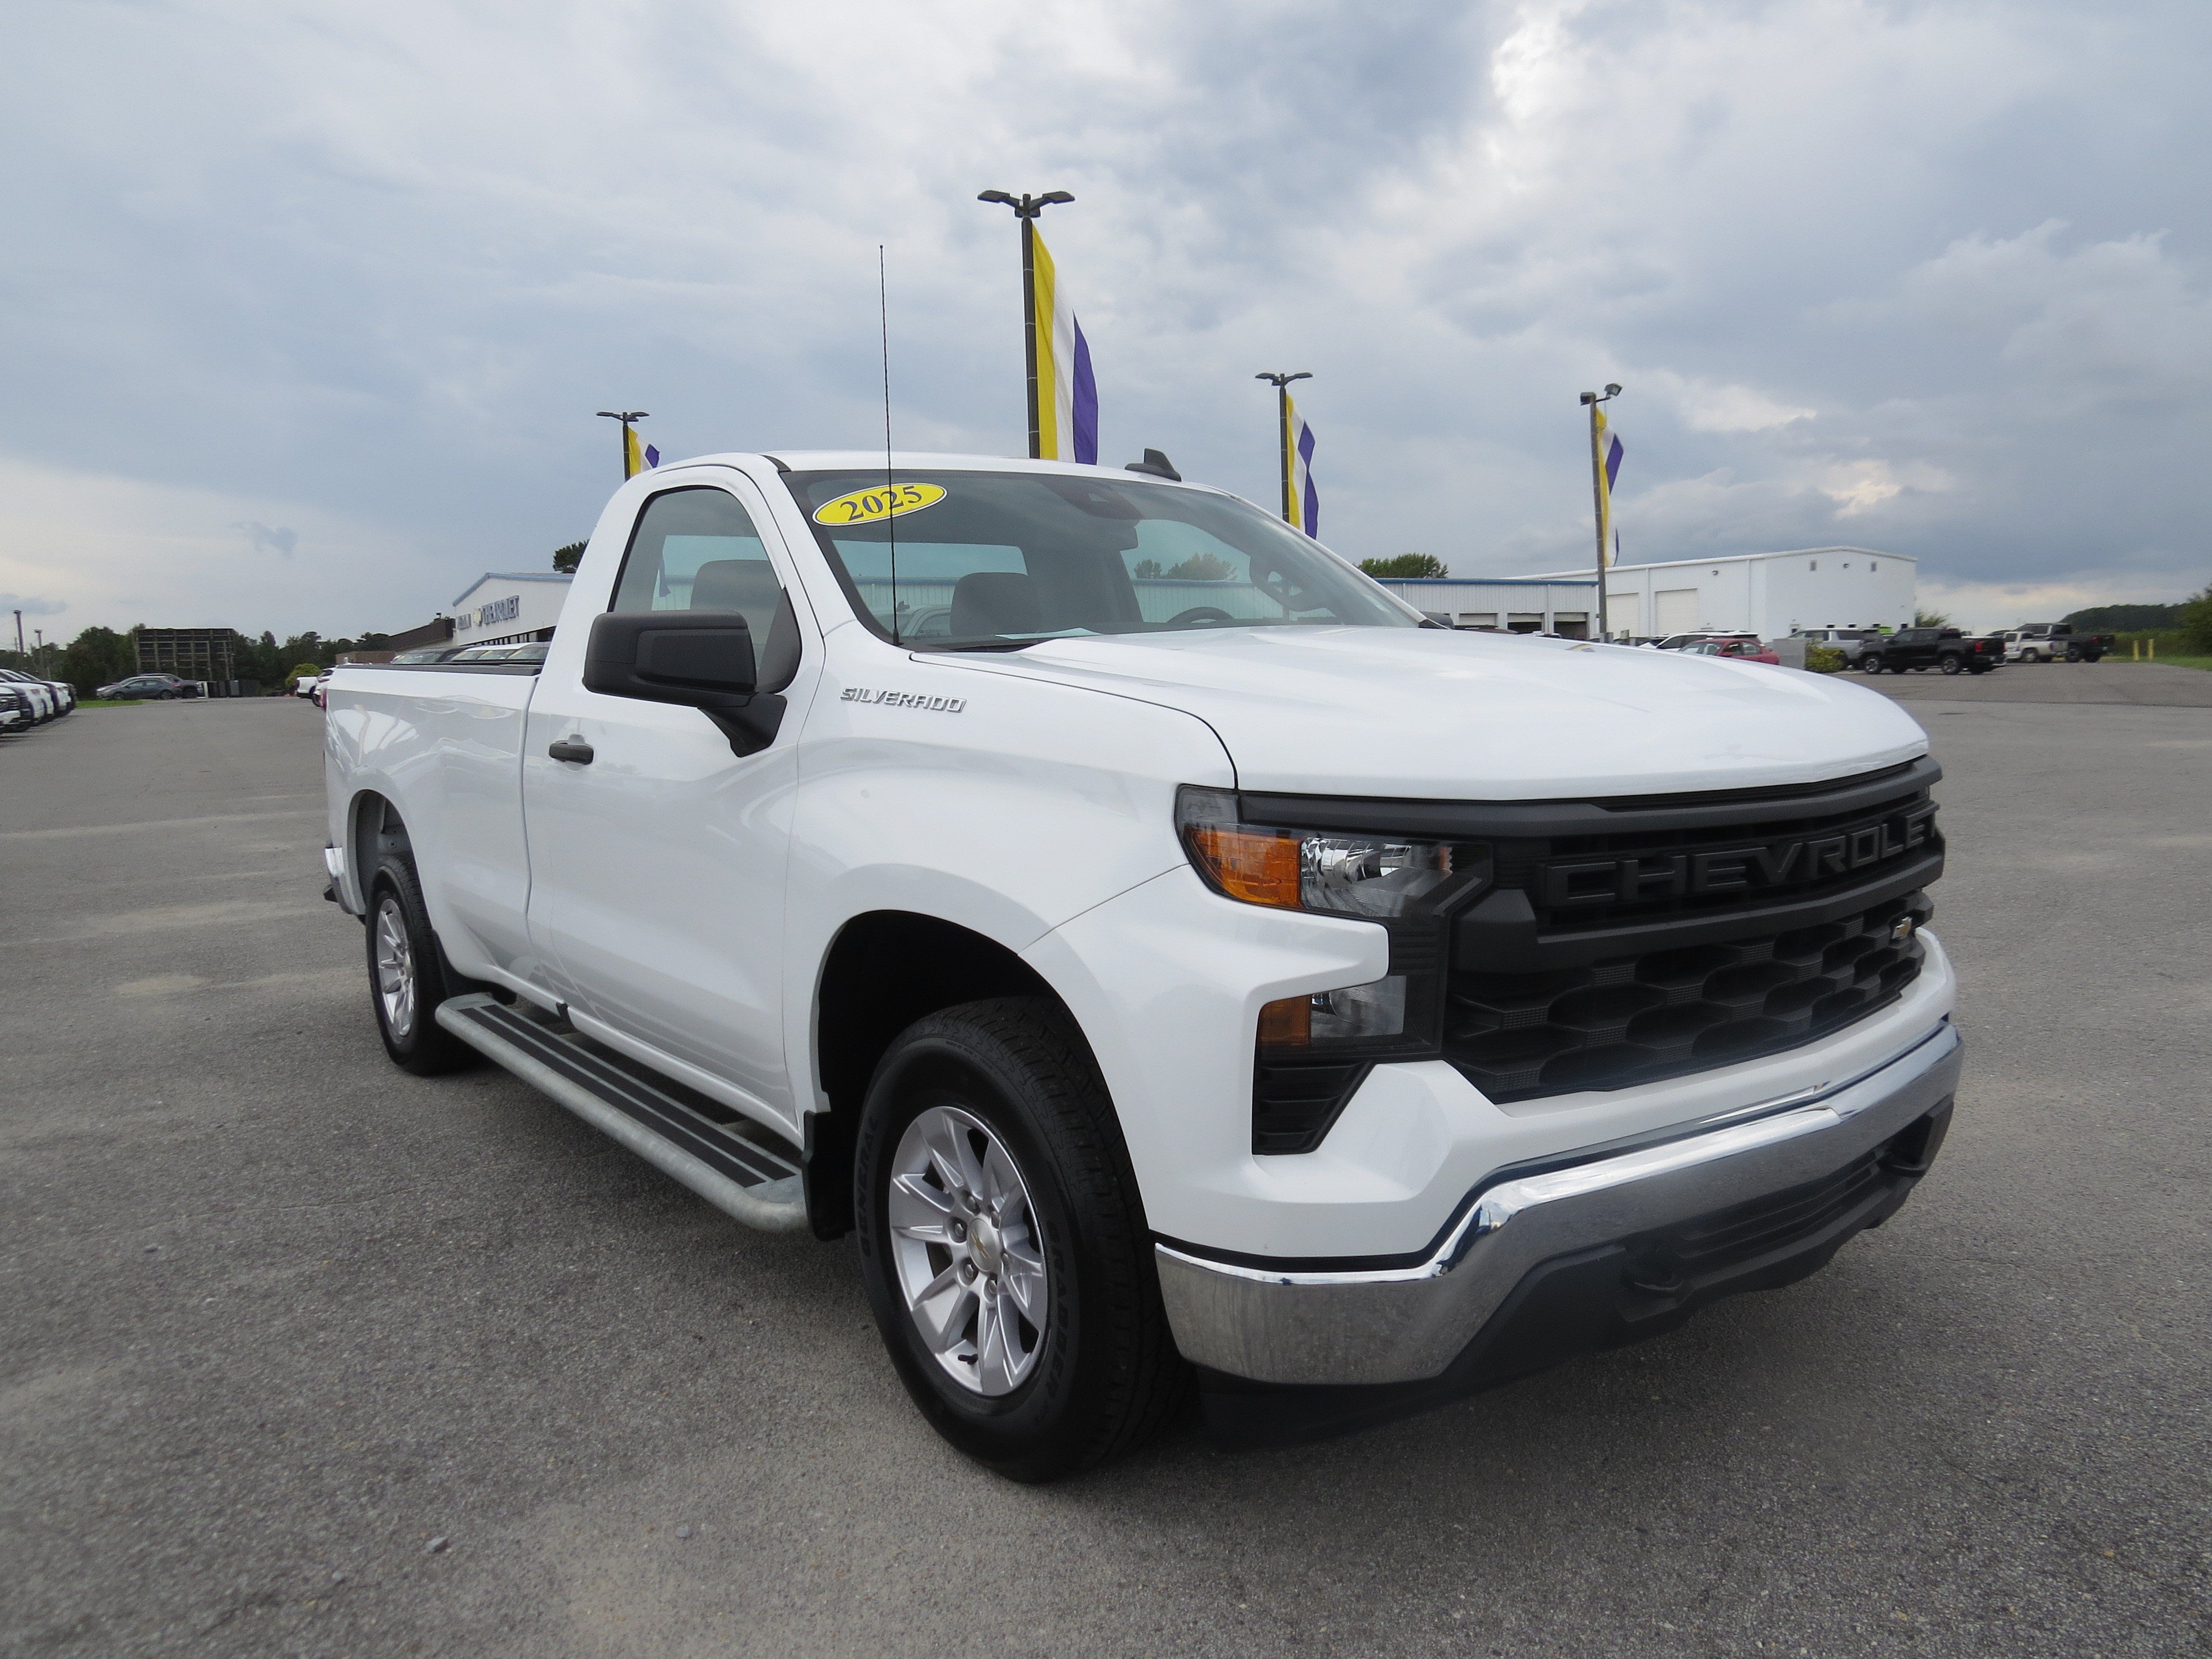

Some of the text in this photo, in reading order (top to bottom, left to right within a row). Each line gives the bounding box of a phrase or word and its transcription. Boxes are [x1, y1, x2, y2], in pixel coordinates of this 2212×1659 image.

[839, 485, 923, 521] 2025
[839, 687, 967, 713] SILVERADO
[1541, 802, 1940, 907] CHEVROLET
[857, 1114, 879, 1258] GENERAL
[1045, 1219, 1069, 1399] GRABBER
